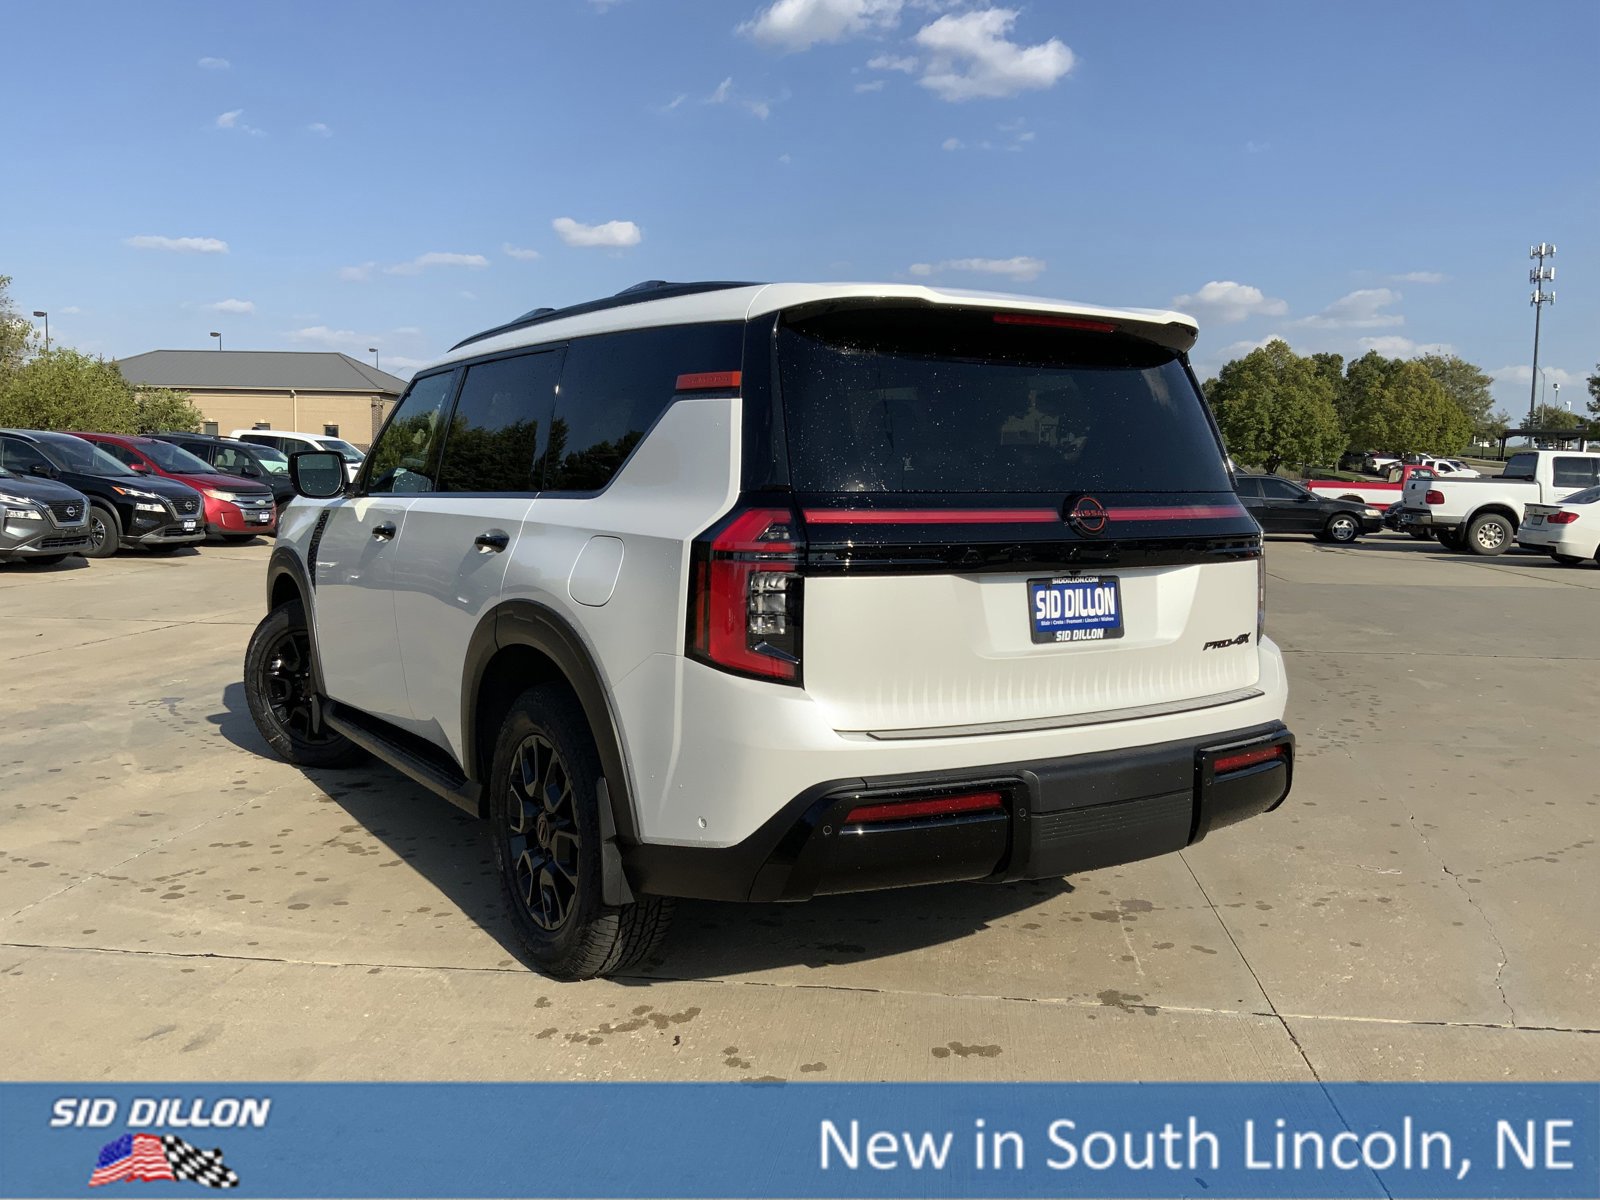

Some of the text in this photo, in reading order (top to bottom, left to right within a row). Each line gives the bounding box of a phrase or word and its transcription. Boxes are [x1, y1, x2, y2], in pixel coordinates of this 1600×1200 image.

[1036, 587, 1115, 619] SID DILLON
[1056, 628, 1104, 641] SID DILLON
